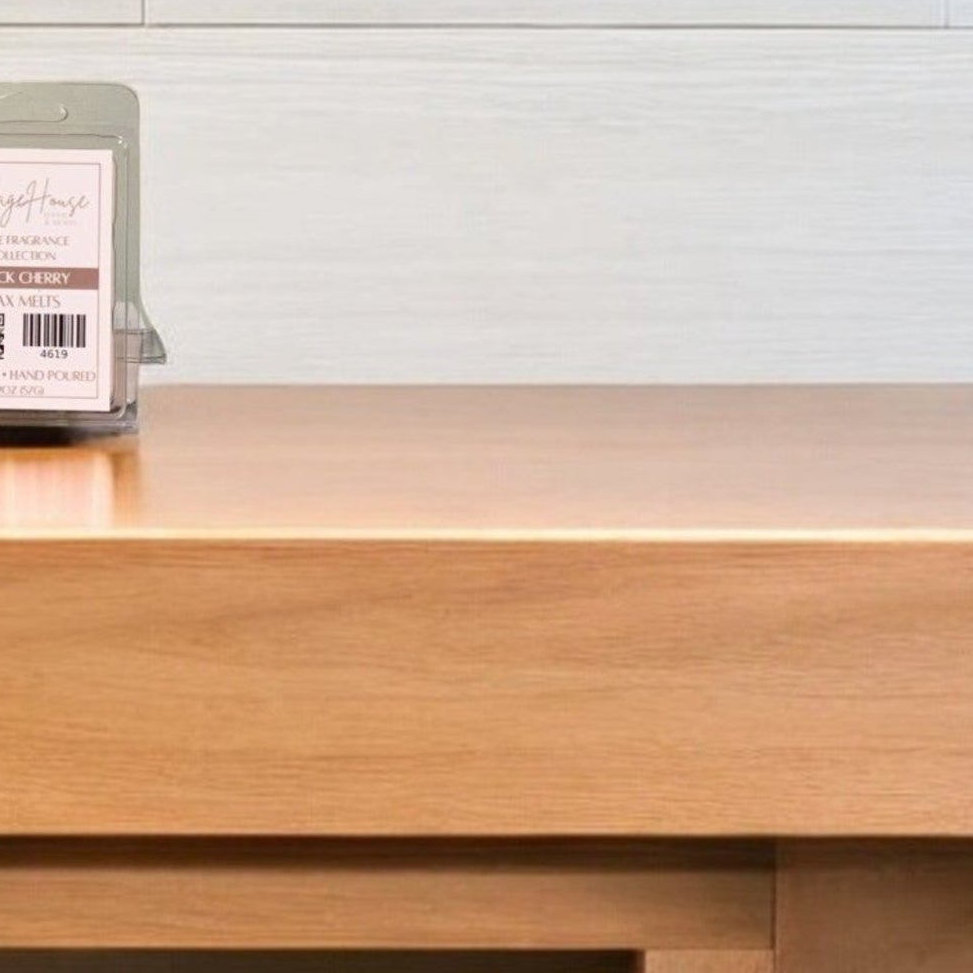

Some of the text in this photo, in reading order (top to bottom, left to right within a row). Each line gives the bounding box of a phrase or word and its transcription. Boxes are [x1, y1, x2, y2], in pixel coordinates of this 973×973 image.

[6, 235, 70, 246] FRAGRANCE
[19, 271, 71, 284] CHERRY
[17, 295, 61, 308] MELTS
[40, 349, 68, 359] 4619
[10, 370, 45, 381] HAND
[47, 371, 96, 382] POURED
